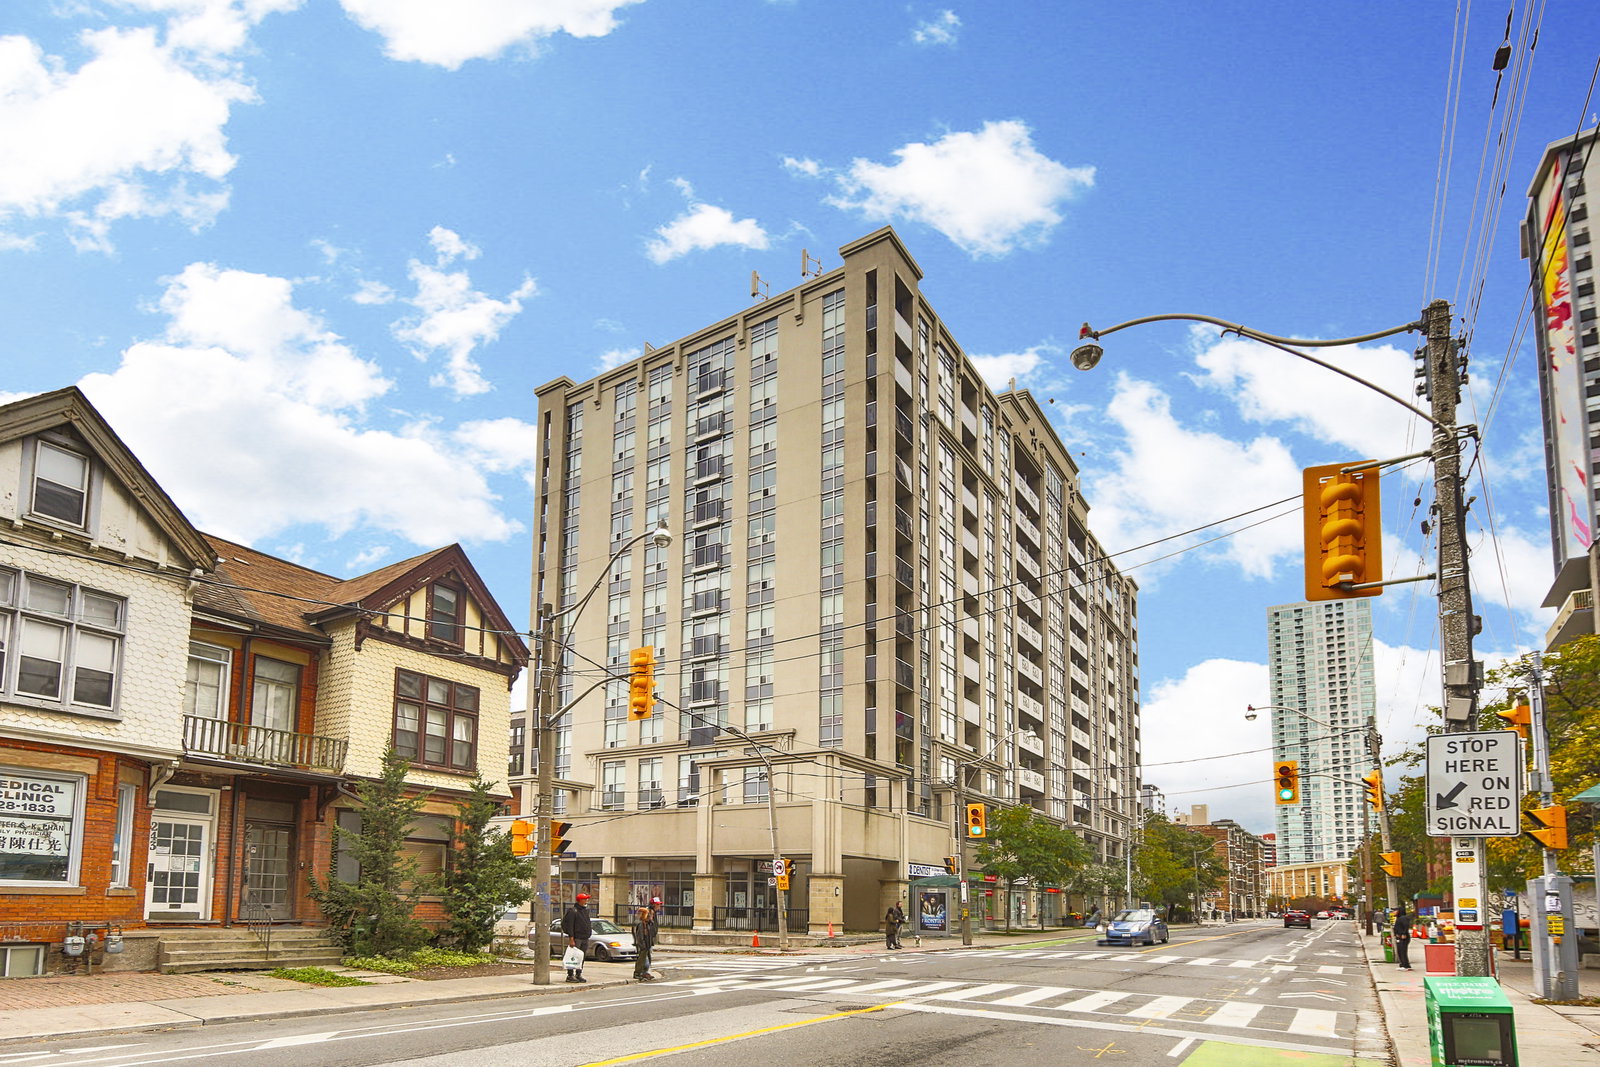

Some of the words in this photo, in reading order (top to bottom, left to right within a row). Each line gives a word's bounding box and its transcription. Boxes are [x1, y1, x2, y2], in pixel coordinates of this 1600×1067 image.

[1447, 740, 1498, 754] STOP
[1446, 759, 1498, 773] HERE
[1482, 777, 1509, 790] ON
[1470, 797, 1510, 810] RED
[1437, 817, 1510, 830] SIGNAL
[149, 822, 158, 850] 243
[913, 865, 931, 875] DENTIST
